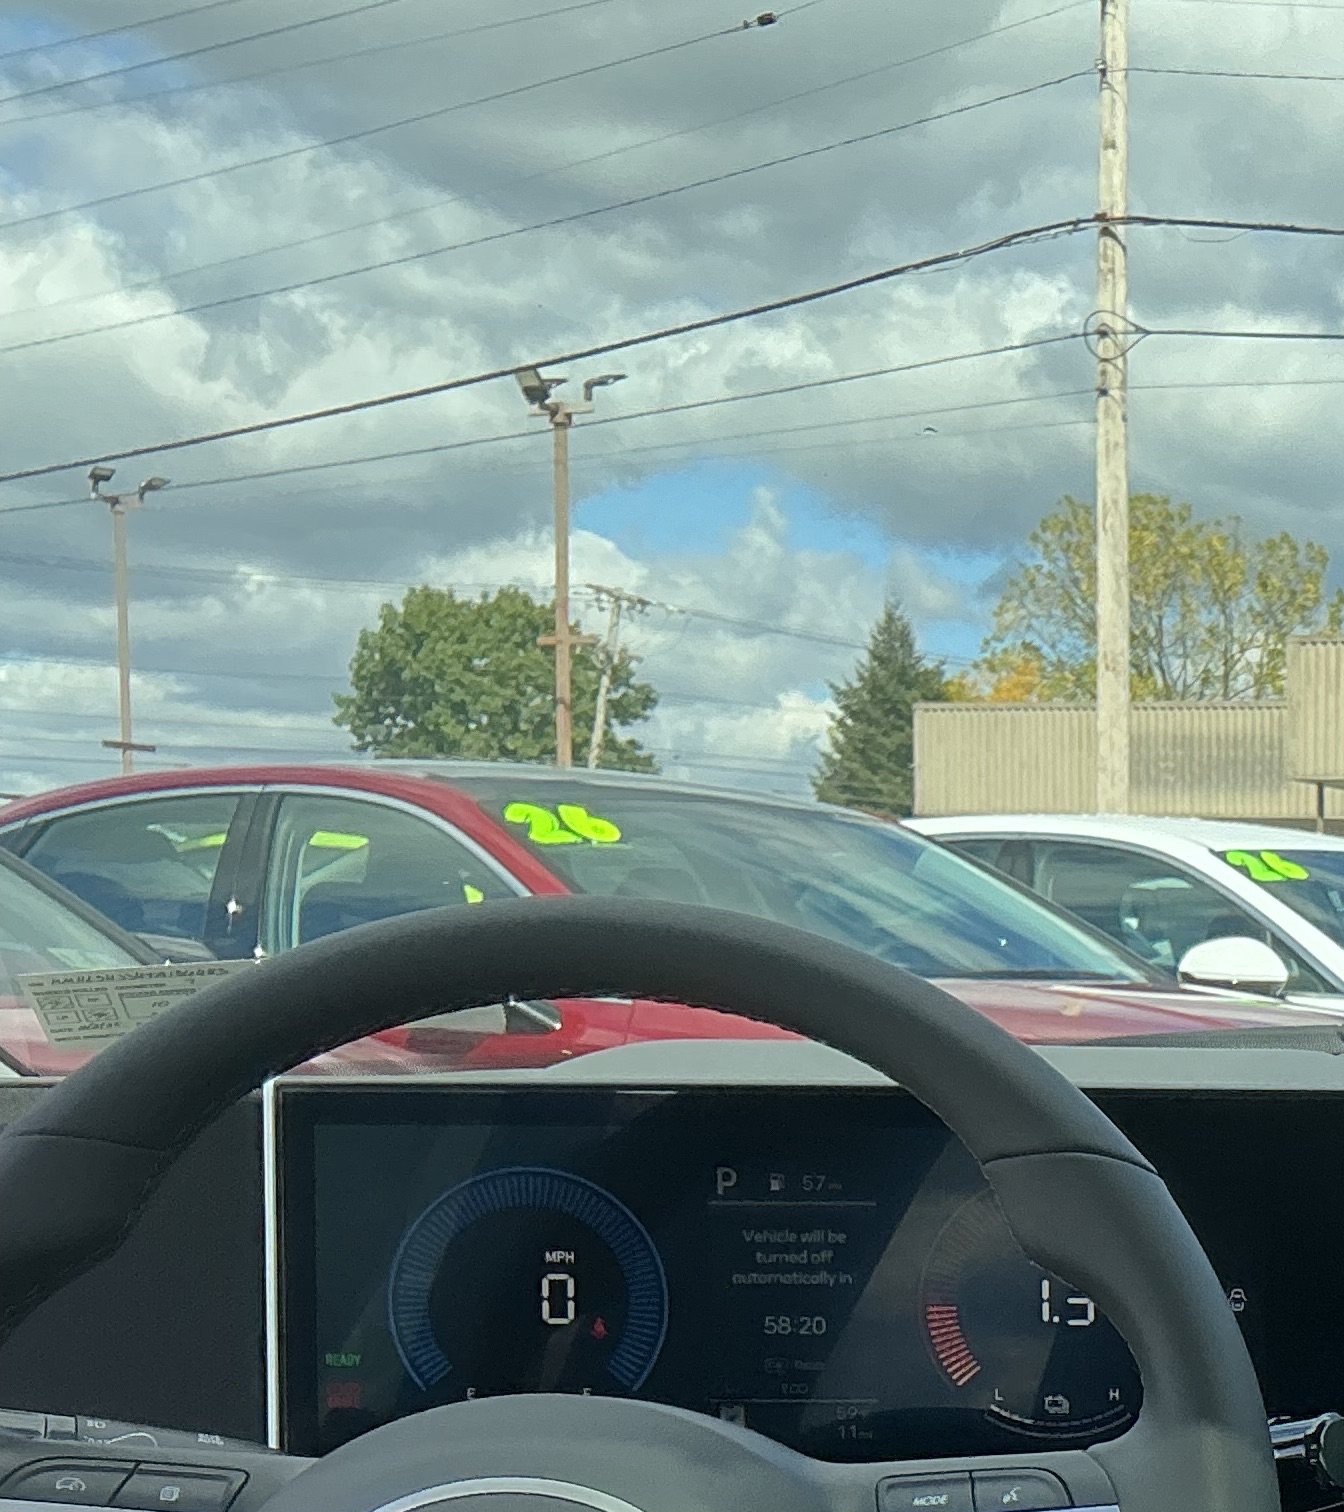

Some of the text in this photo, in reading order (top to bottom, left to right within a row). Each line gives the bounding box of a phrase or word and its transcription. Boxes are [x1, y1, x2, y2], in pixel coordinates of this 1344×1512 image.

[503, 802, 622, 845] 26
[715, 1167, 738, 1194] P
[800, 1174, 826, 1192] 57
[742, 1229, 847, 1244] Vehicle will be
[544, 1250, 576, 1264] MPH
[755, 1250, 834, 1264] turned off
[731, 1271, 854, 1287] automatically in
[540, 1272, 577, 1326] 0
[763, 1316, 828, 1336] 58:20
[912, 1494, 949, 1507] MODE
